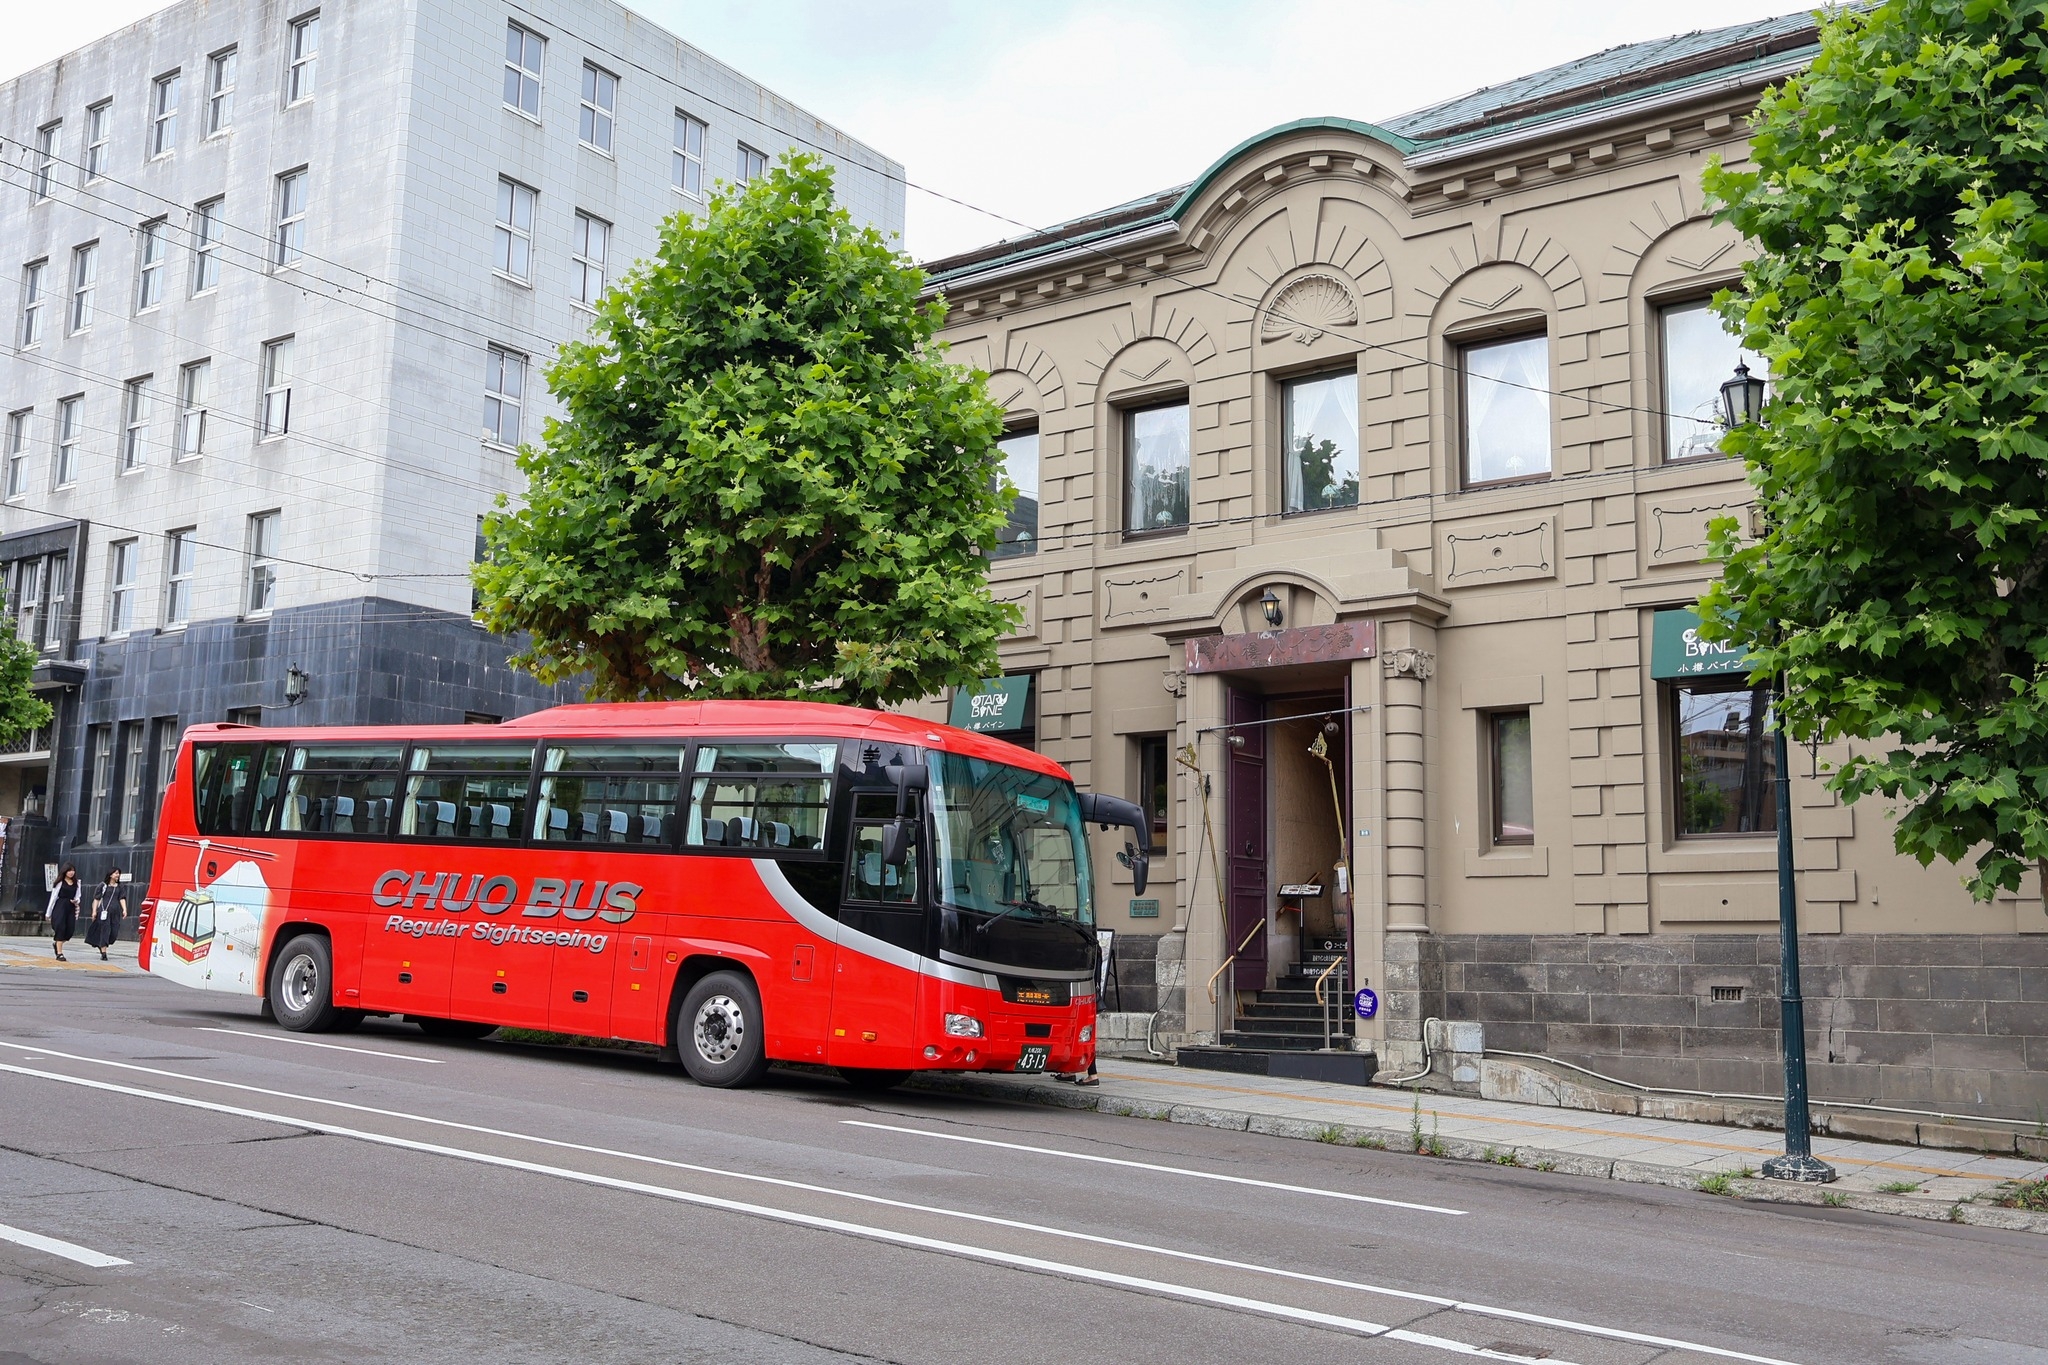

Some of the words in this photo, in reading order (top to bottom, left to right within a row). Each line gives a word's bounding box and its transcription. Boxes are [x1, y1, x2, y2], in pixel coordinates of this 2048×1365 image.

[372, 869, 519, 915] CHUO
[521, 877, 644, 923] BUS
[384, 915, 470, 938] Regular
[471, 921, 609, 954] Sightseeing
